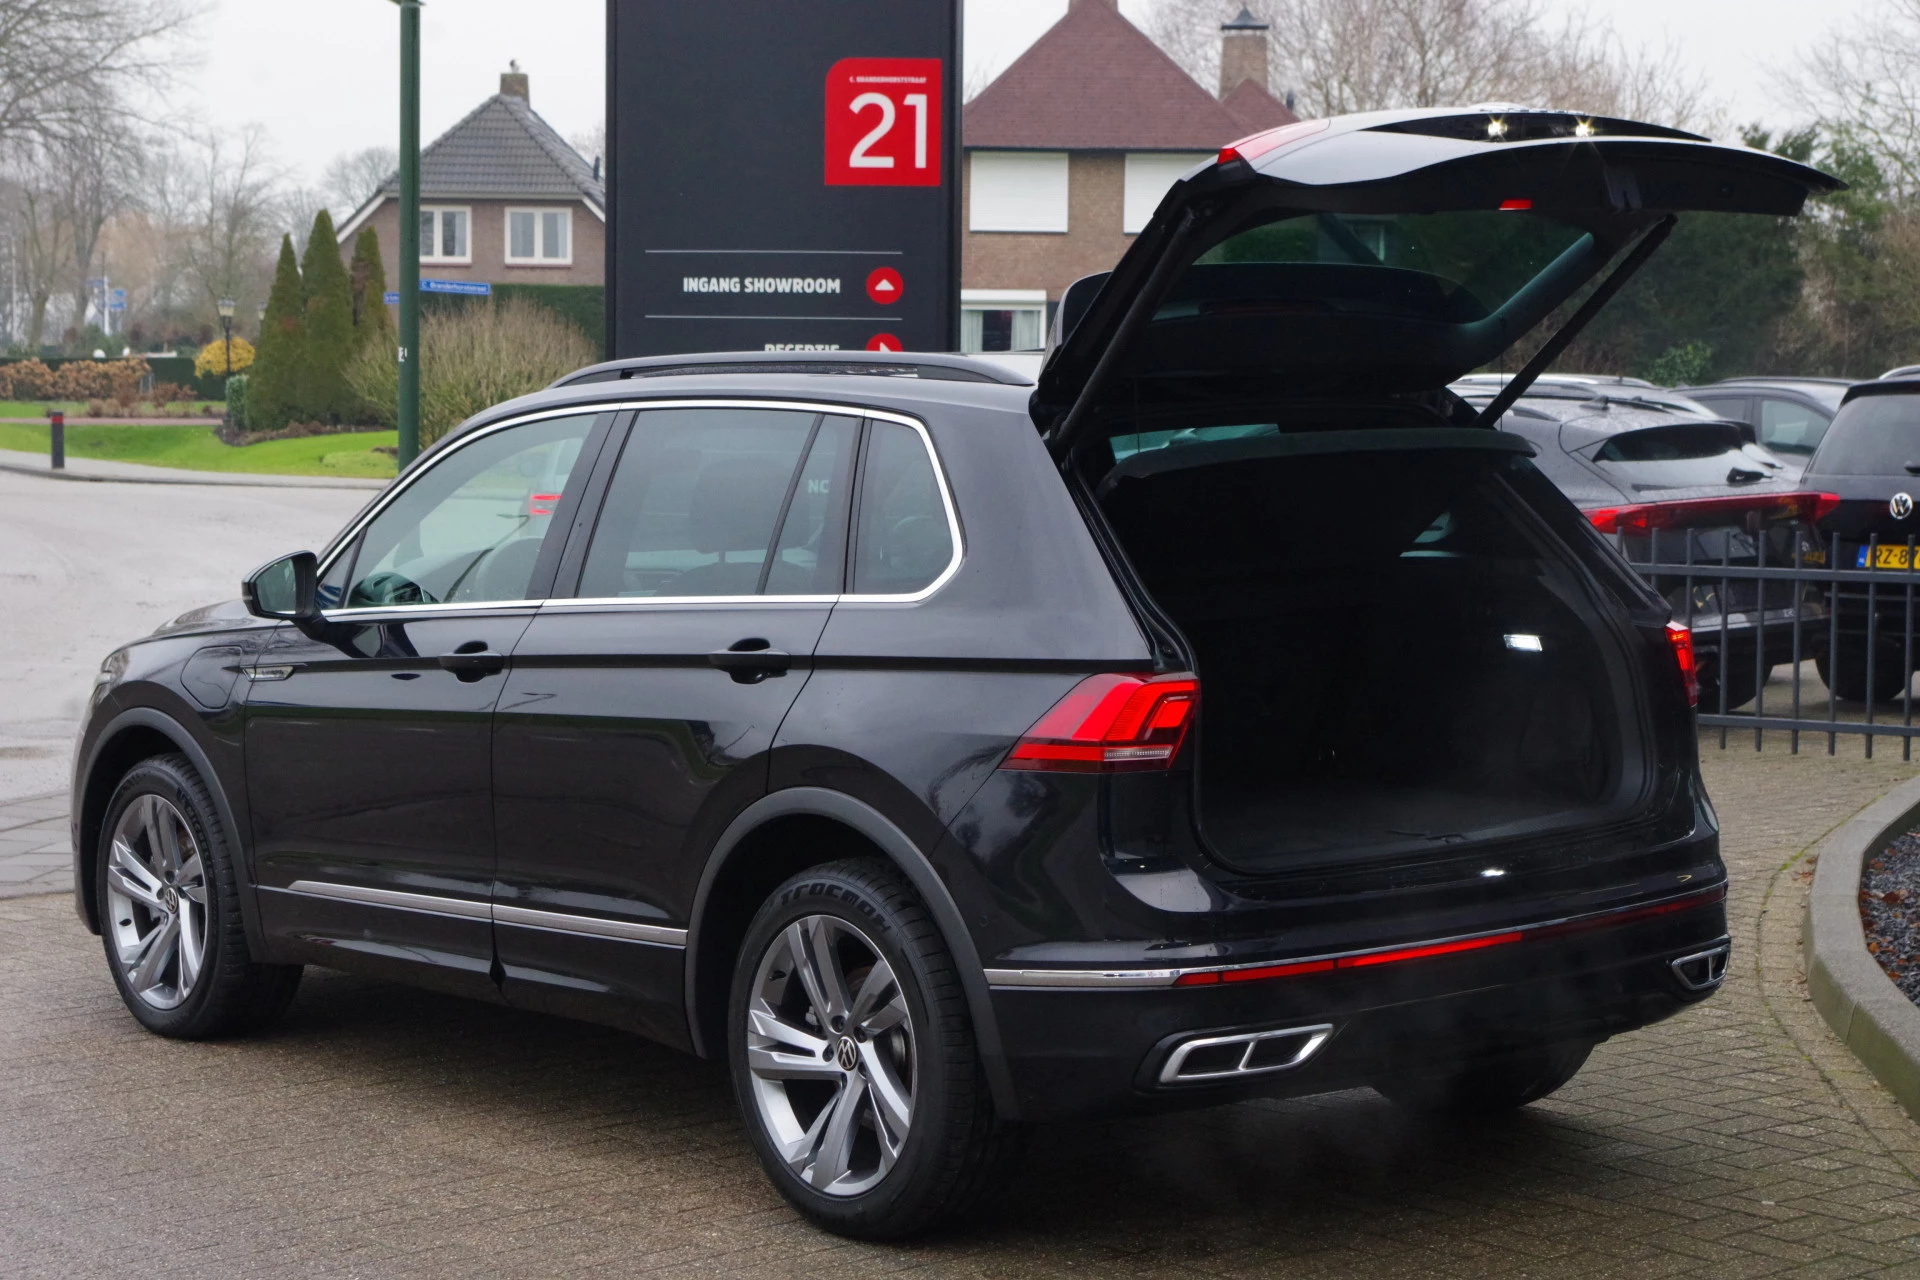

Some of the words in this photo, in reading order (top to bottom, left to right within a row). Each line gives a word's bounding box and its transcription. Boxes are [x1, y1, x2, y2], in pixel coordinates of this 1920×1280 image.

[849, 92, 928, 169] 21
[683, 277, 741, 293] INGANG
[744, 278, 841, 294] SHOWROOM
